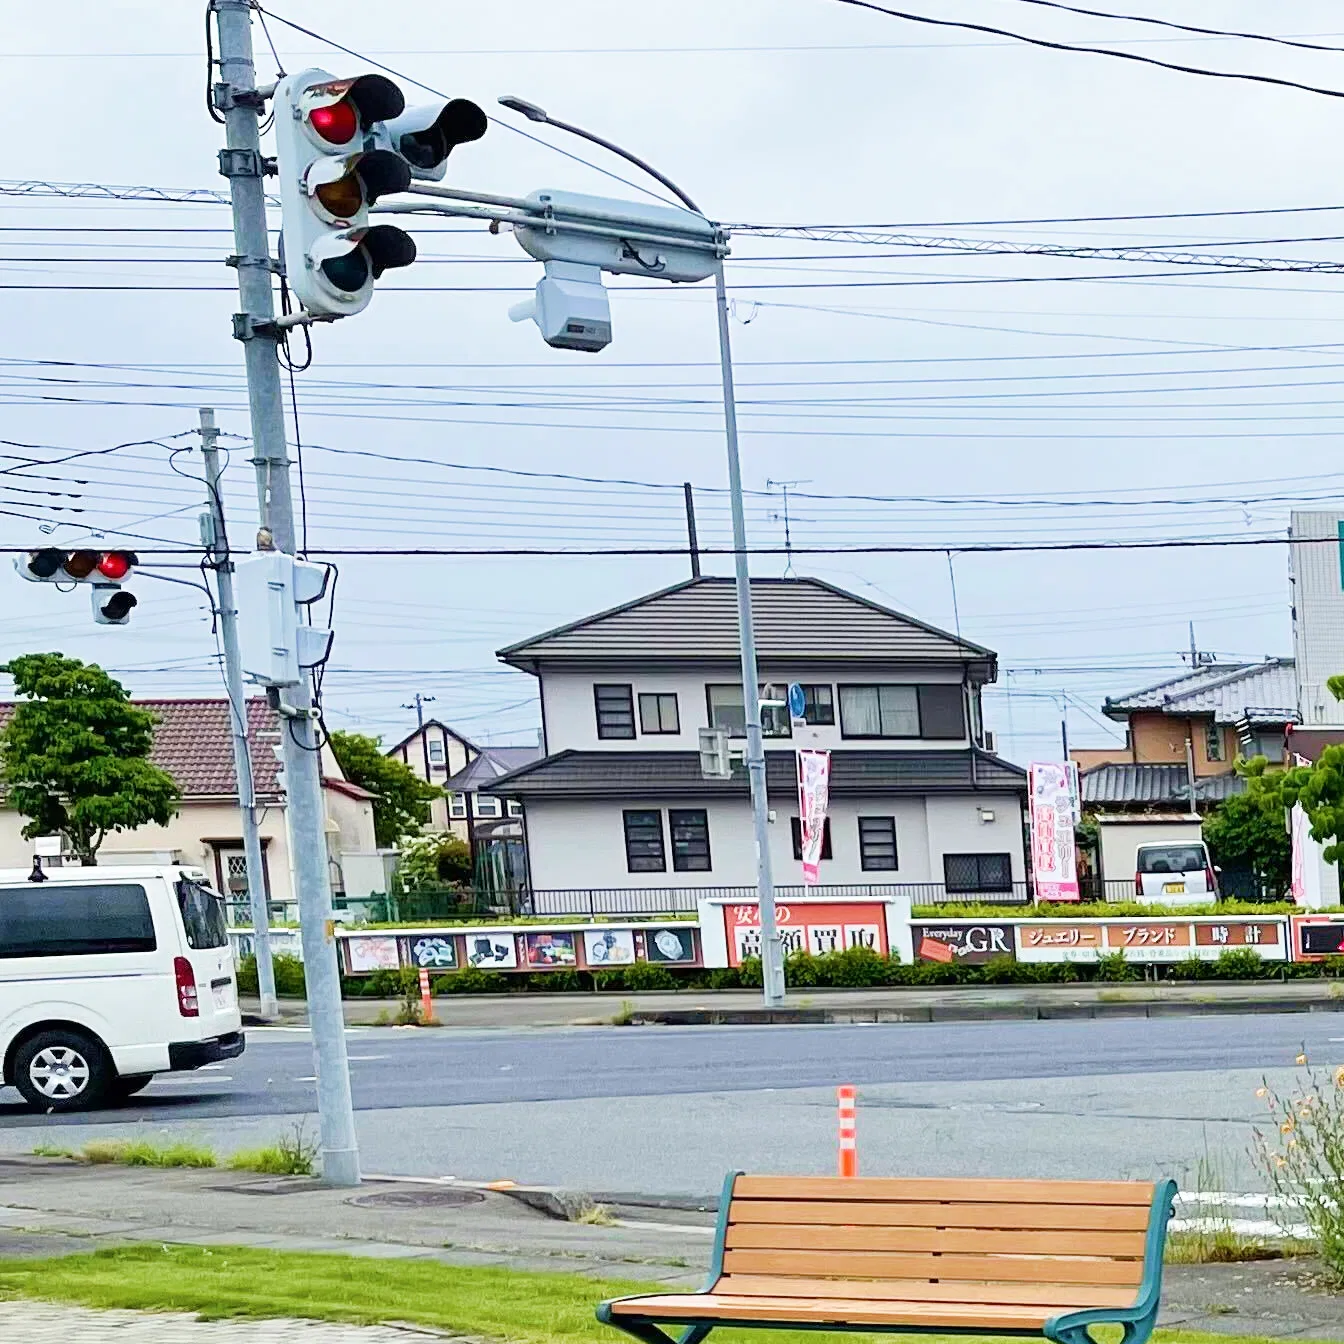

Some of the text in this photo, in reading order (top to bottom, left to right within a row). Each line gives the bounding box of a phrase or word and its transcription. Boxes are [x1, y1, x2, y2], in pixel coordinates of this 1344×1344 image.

[733, 905, 791, 924] 安の
[922, 928, 963, 941] Everyday
[965, 927, 1011, 953] GR
[1029, 928, 1096, 945] ジュエリー
[1122, 927, 1175, 944] ブランド
